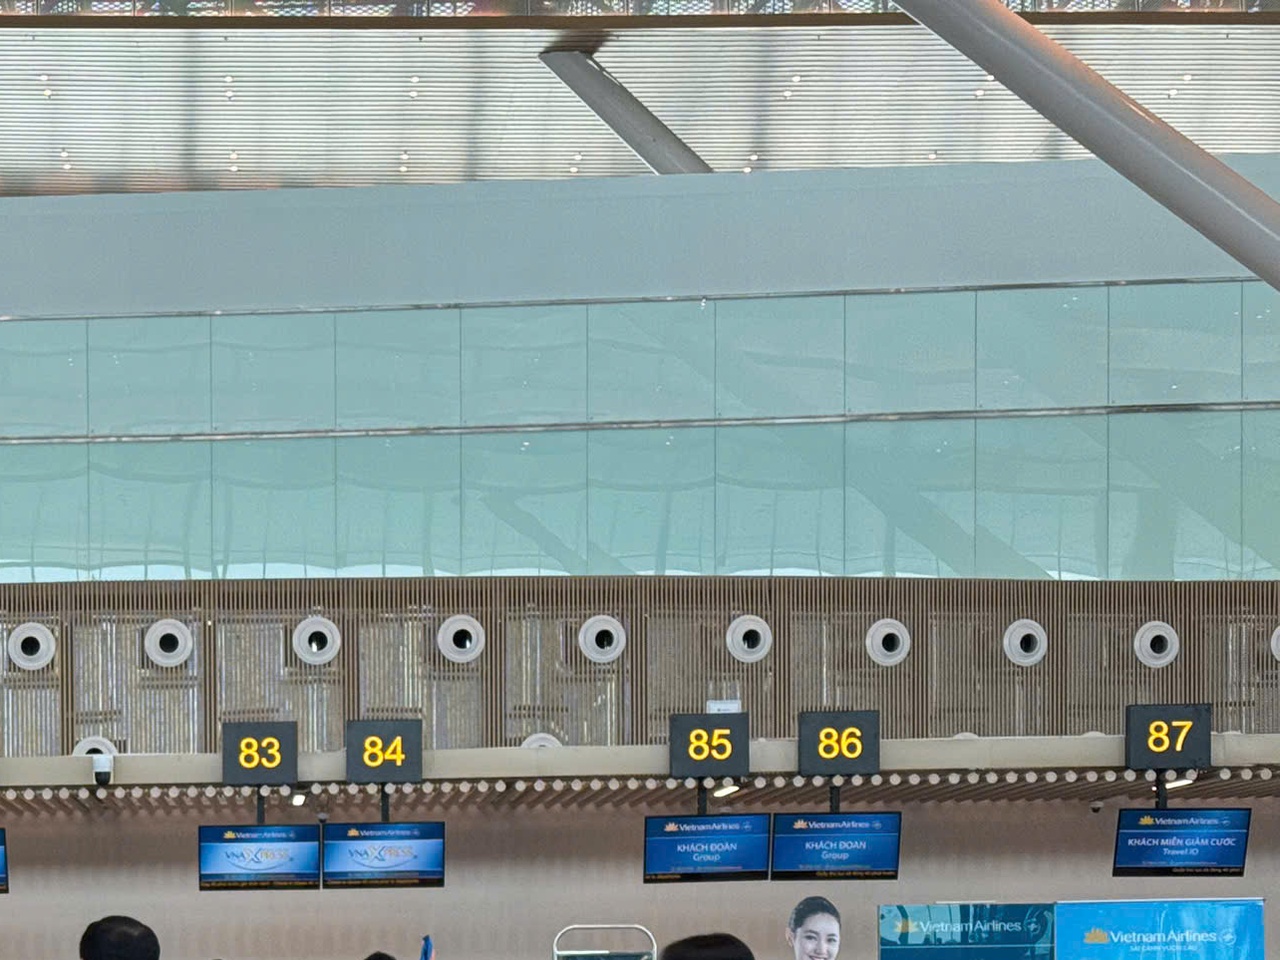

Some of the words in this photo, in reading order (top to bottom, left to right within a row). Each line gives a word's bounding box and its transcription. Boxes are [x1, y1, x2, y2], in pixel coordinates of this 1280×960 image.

[238, 736, 282, 769] 83
[362, 735, 406, 768] 84
[687, 727, 733, 761] 85
[818, 726, 864, 760] 86
[1147, 720, 1194, 753] 87
[693, 853, 721, 862] Group
[821, 851, 850, 860] Group
[920, 919, 972, 933] Vietnam
[973, 918, 1022, 932] Airlines
[1109, 930, 1167, 944] Vietnam
[1167, 928, 1217, 943] Airlines
